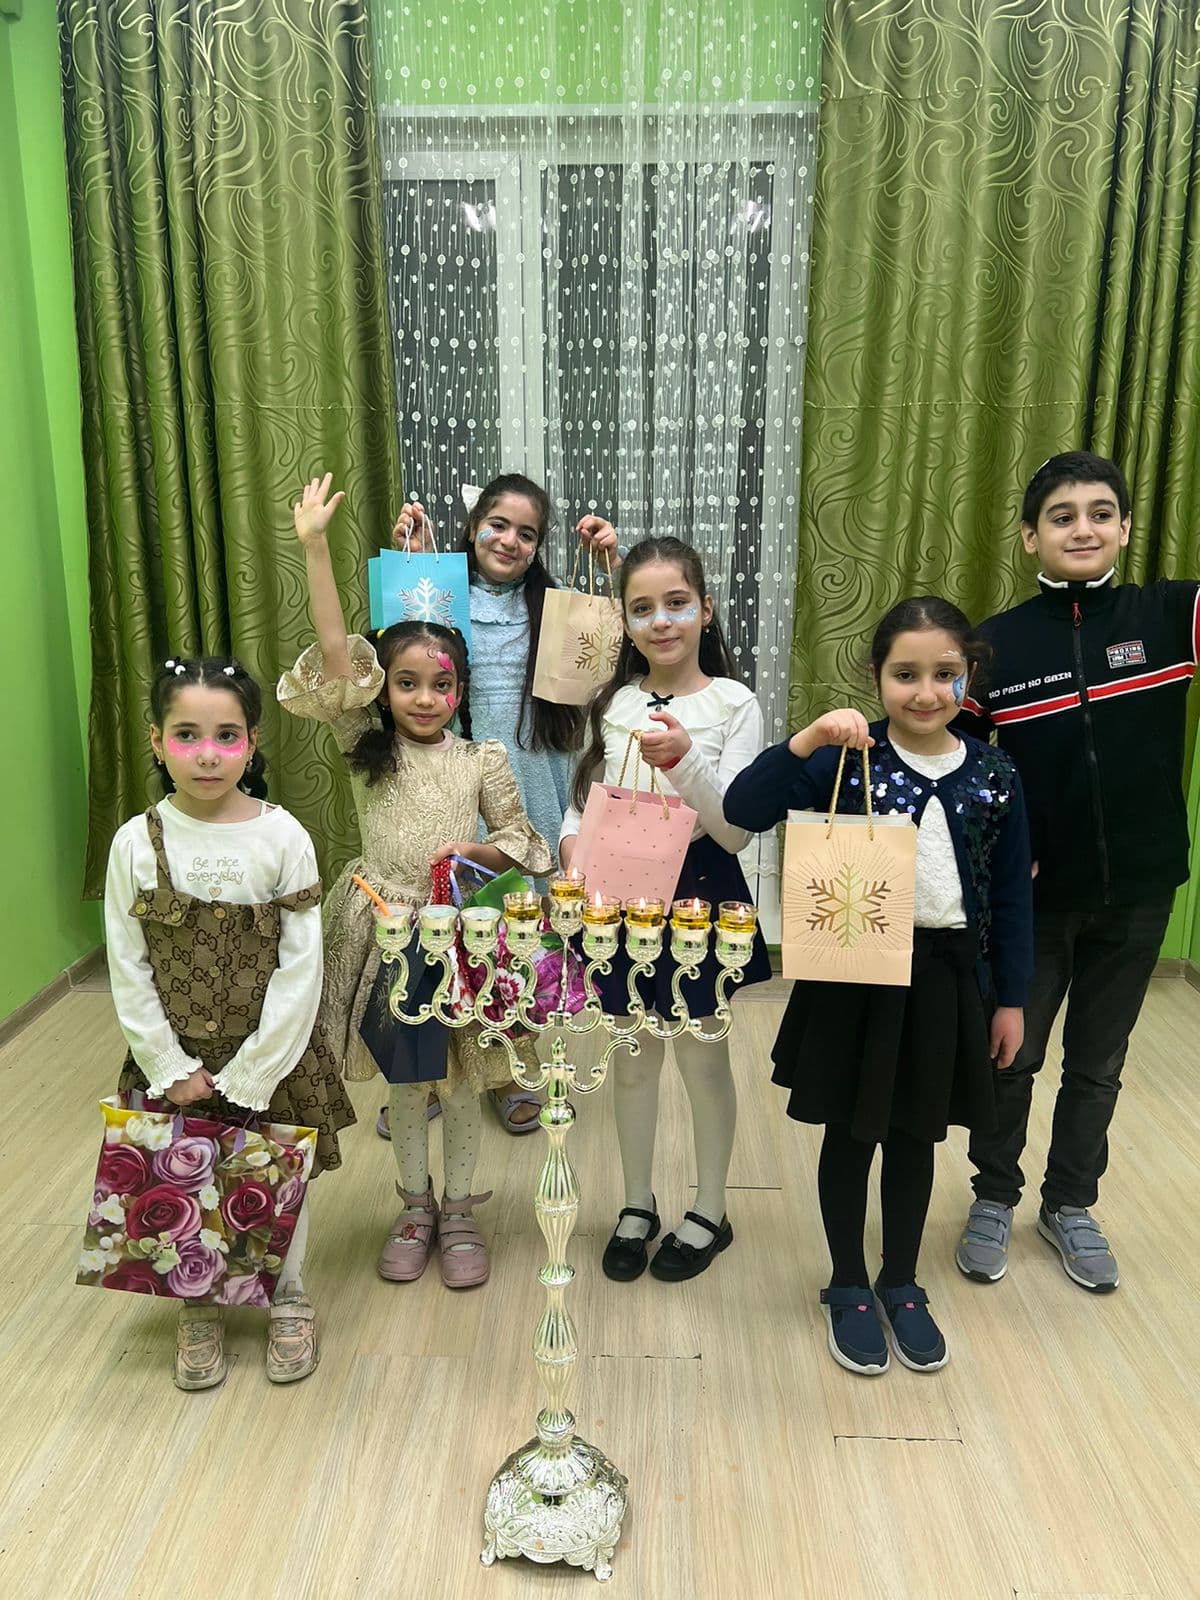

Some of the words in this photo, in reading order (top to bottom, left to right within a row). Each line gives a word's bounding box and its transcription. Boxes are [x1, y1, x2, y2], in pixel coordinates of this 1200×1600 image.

[988, 689, 1001, 699] NO
[1002, 682, 1026, 696] PAIN
[1027, 678, 1042, 689] NO
[1043, 671, 1072, 684] GAIN
[192, 856, 209, 871] Be
[216, 856, 240, 868] nice
[186, 868, 244, 886] everyday
